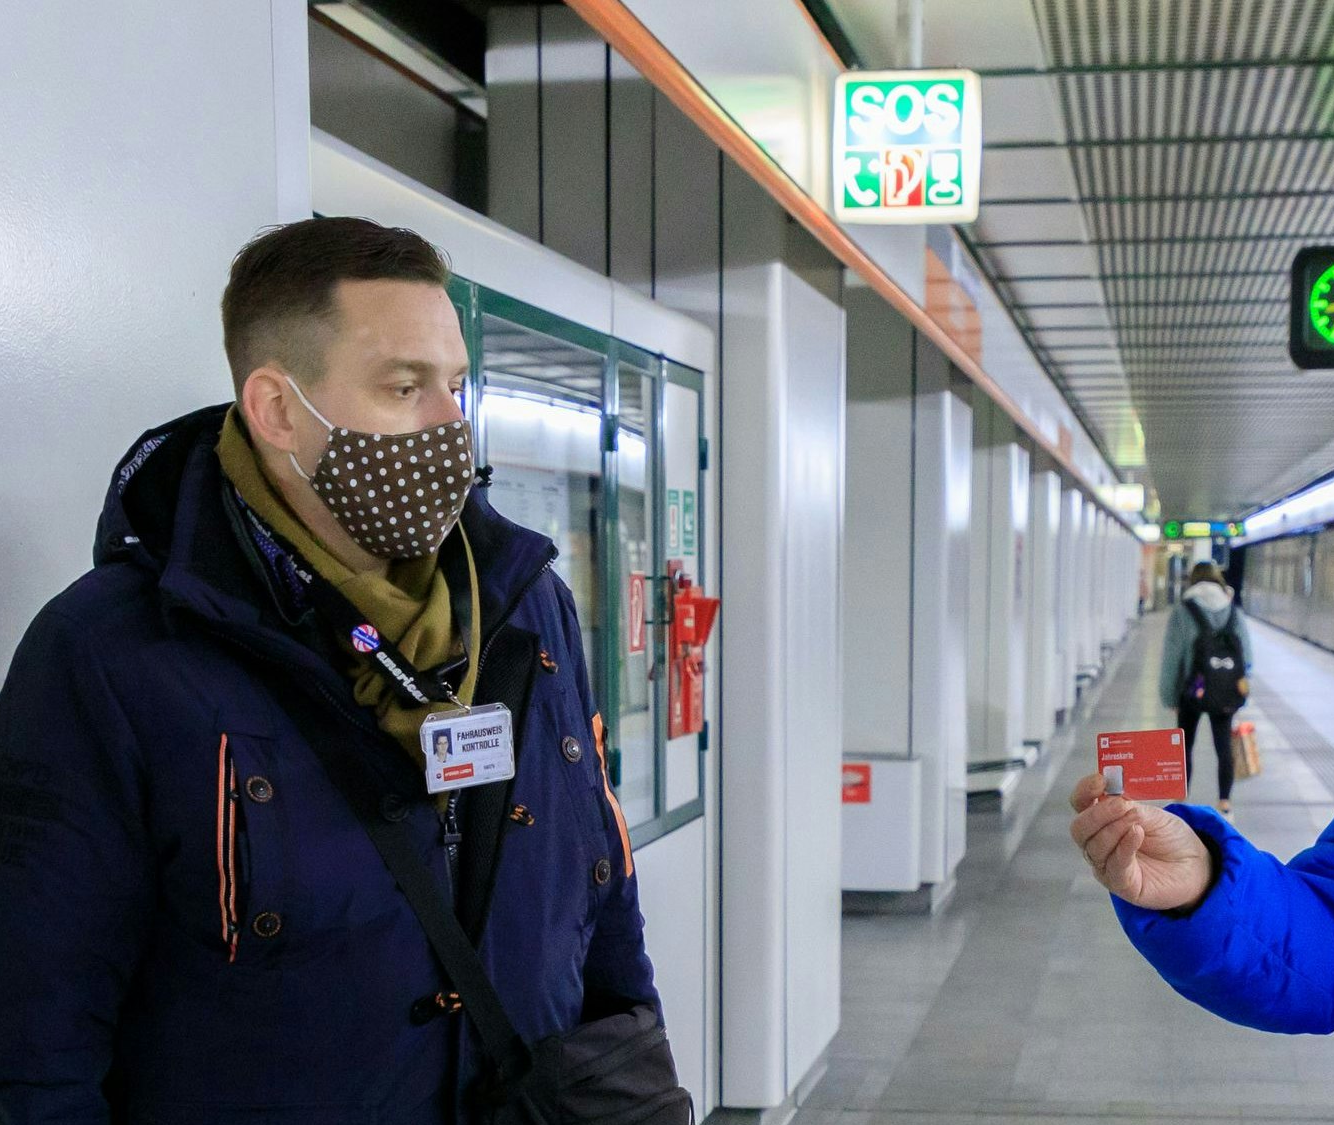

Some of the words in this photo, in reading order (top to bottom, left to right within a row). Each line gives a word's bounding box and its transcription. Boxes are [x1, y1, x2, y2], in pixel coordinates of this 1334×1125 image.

[848, 83, 961, 138] SOS
[457, 725, 503, 741] FAHRAUSWEIS
[462, 738, 500, 753] KONTROLLE
